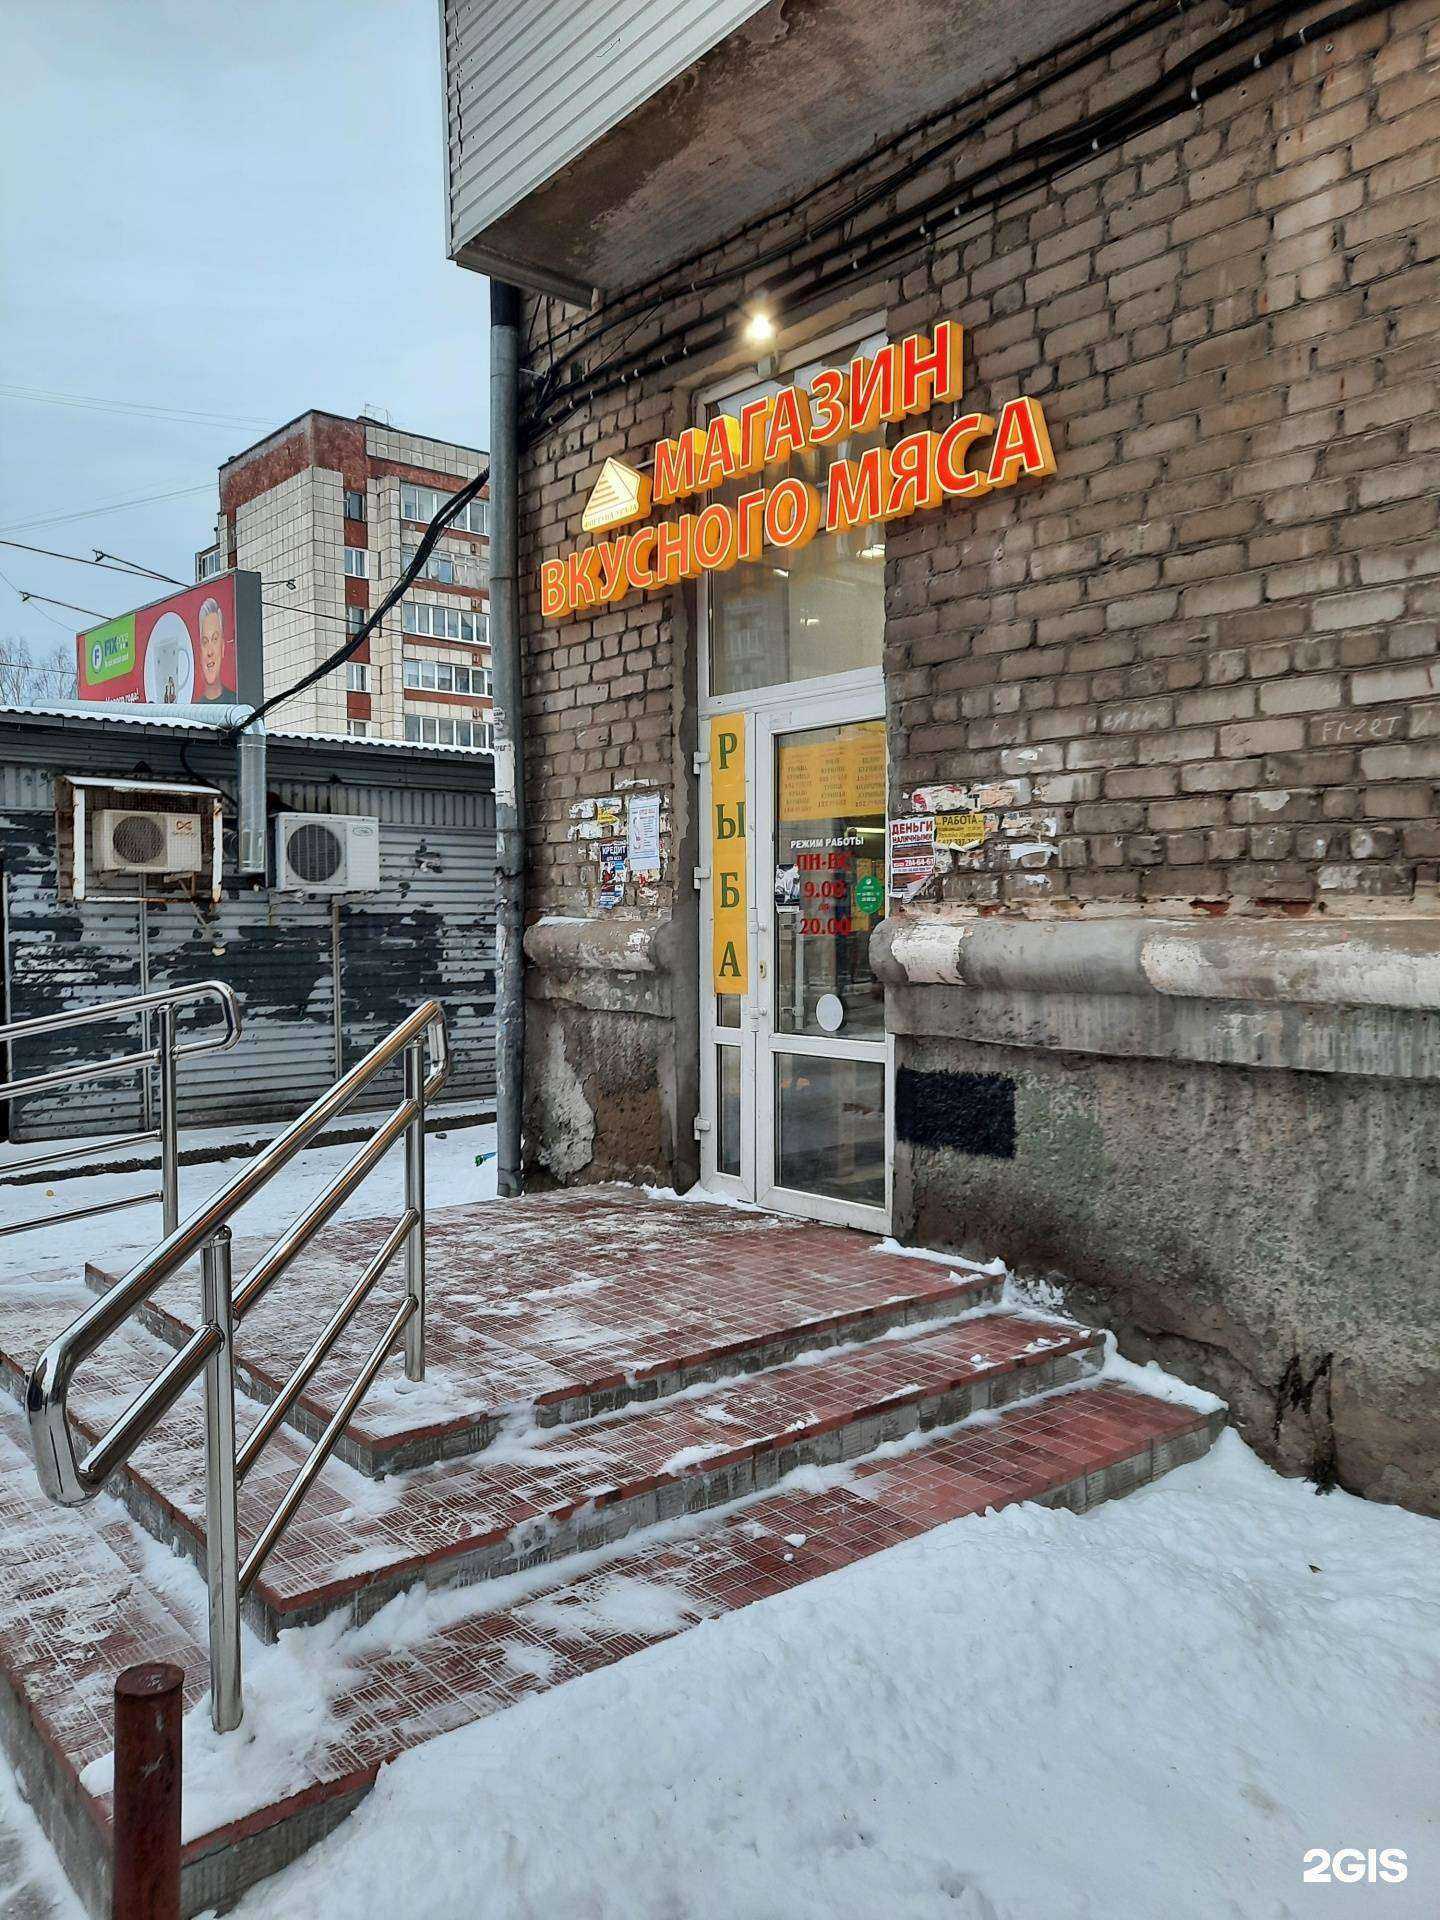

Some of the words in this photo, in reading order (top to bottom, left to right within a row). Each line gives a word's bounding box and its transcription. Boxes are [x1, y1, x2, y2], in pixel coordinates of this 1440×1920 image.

[653, 320, 963, 503] МАГАЗИН
[541, 478, 819, 617] ВКУСНОГО
[826, 396, 1056, 533] МЯСА
[891, 820, 933, 836] ДЕНЬГИ
[942, 814, 978, 825] РАБОТА
[602, 845, 626, 855] КРЕДИТ
[790, 838, 824, 849] РЕЖИМ
[825, 836, 864, 847] РАБОТЫ
[804, 880, 846, 899] 9.00
[799, 917, 852, 935] 20.00
